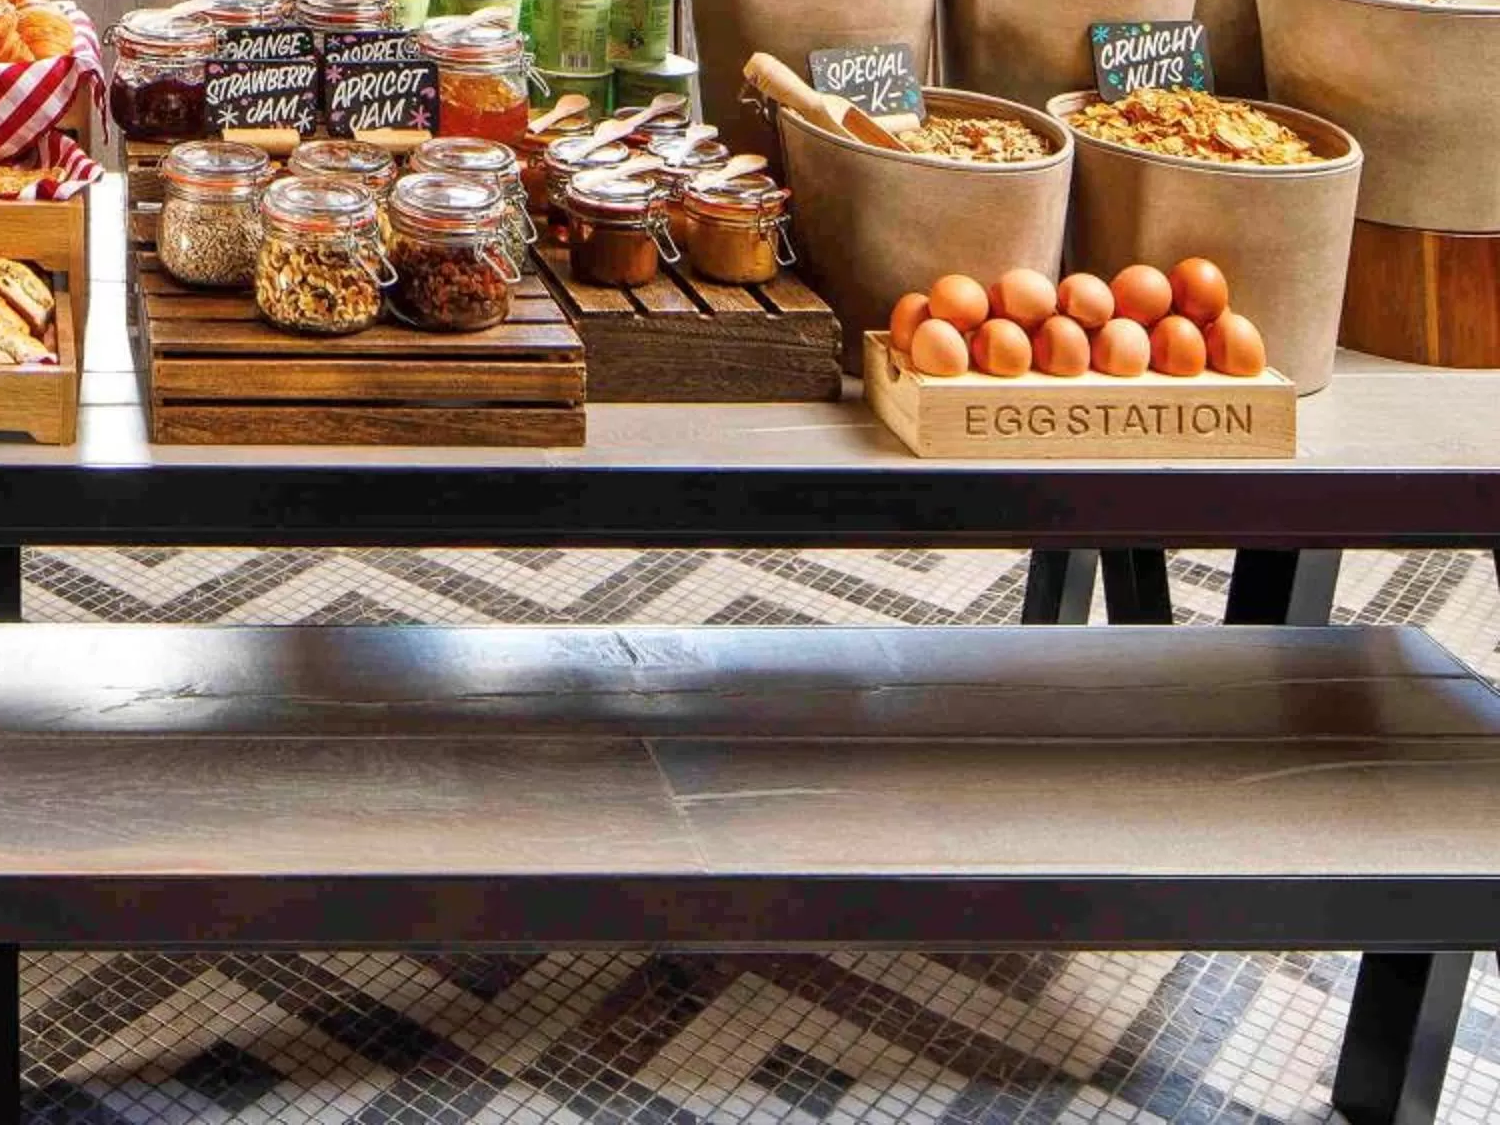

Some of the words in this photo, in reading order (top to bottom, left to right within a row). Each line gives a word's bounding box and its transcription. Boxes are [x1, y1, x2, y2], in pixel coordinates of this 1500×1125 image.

[1101, 25, 1204, 70] CRUNCHY
[206, 66, 317, 105] STRAWBERRY
[332, 69, 428, 109] APRICOT
[826, 51, 908, 91] SPECIAL
[1125, 56, 1185, 93] NUTS
[246, 94, 299, 124] JAM
[350, 99, 405, 131] JAM
[964, 404, 1056, 436] EGG
[1066, 403, 1253, 435] STATION
